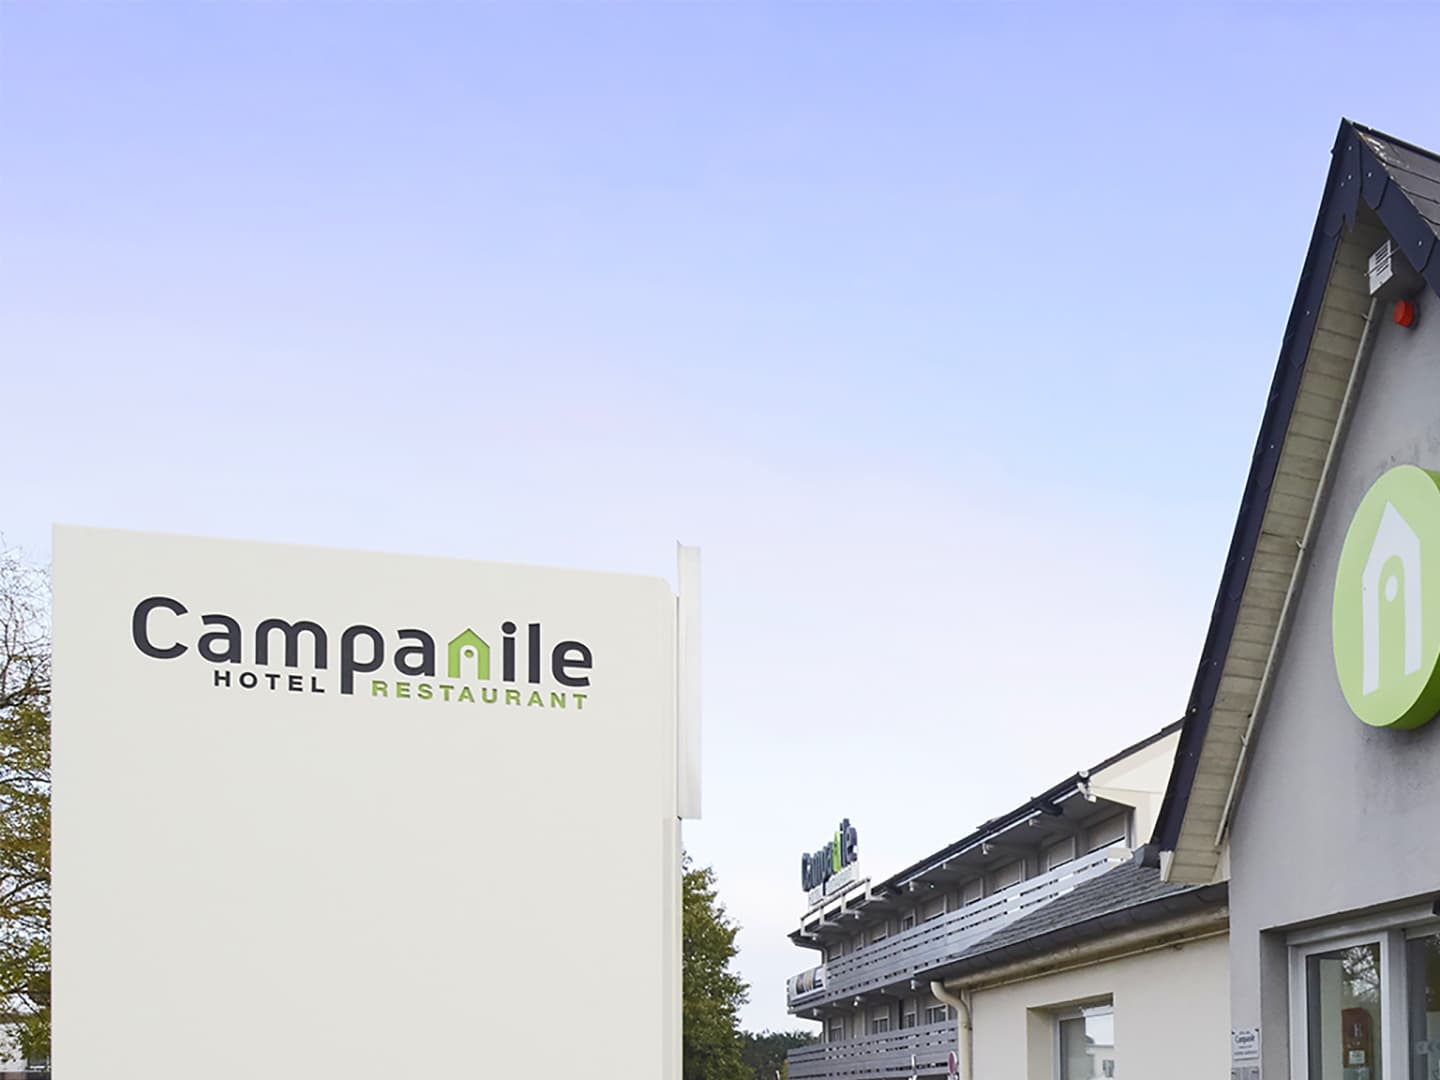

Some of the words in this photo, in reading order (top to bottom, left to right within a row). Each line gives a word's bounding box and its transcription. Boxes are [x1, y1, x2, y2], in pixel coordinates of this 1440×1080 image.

[132, 596, 594, 695] Campanile
[214, 670, 325, 694] HOTEL
[371, 680, 588, 710] RESTAURANT
